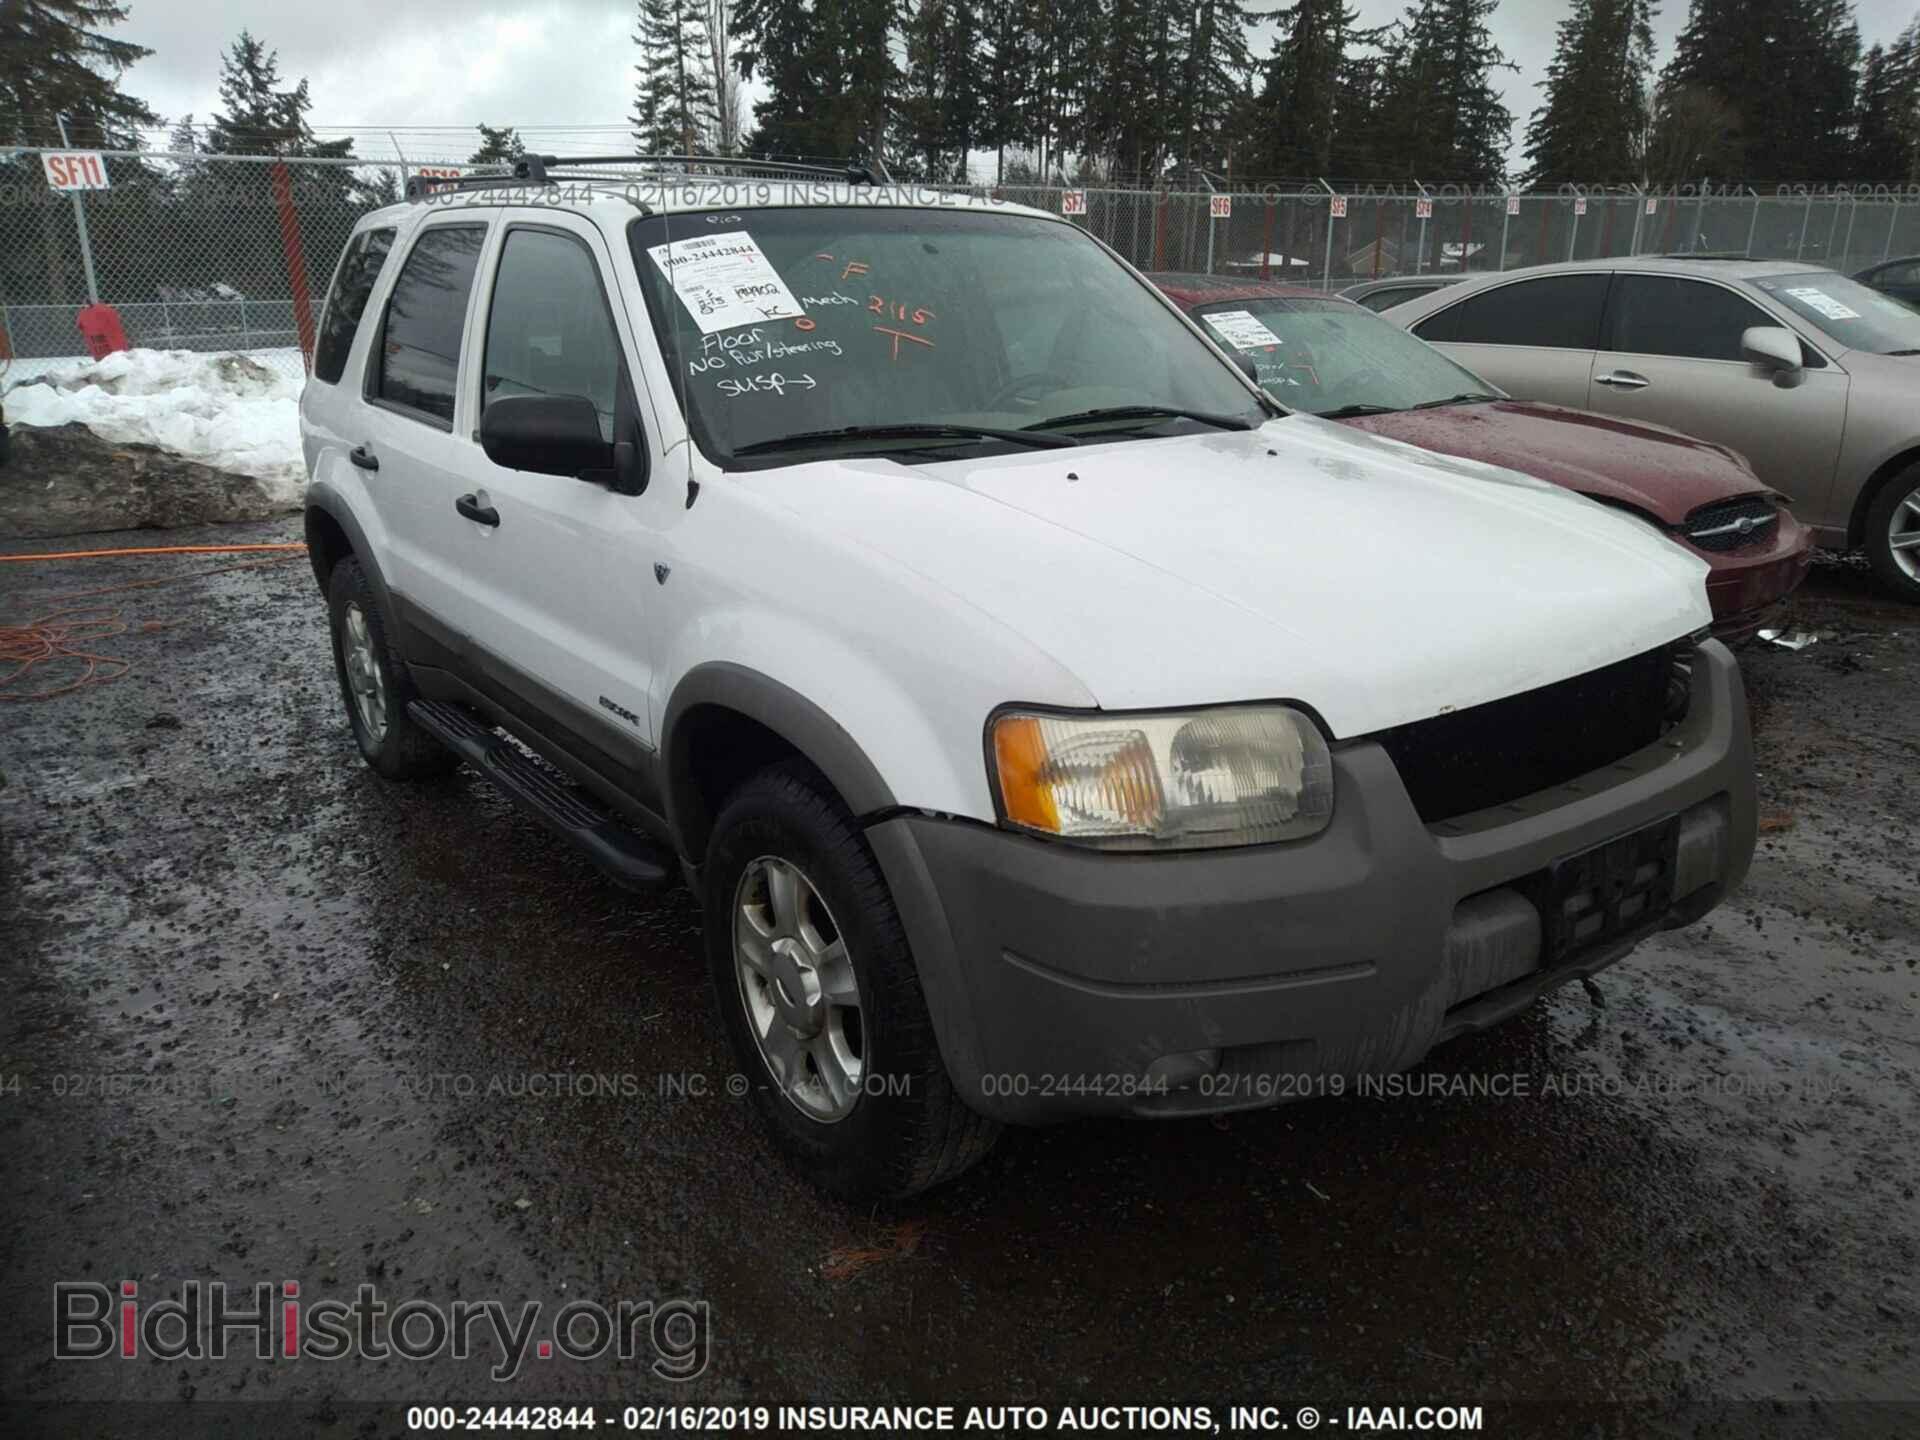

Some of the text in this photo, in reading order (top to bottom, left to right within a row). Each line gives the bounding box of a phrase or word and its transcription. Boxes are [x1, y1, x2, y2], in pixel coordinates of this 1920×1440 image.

[48, 156, 102, 186] SF11
[1065, 193, 1084, 212] SF7
[1211, 197, 1230, 215] SF6
[1332, 198, 1346, 215] SF5
[663, 245, 754, 268] 000-24442844
